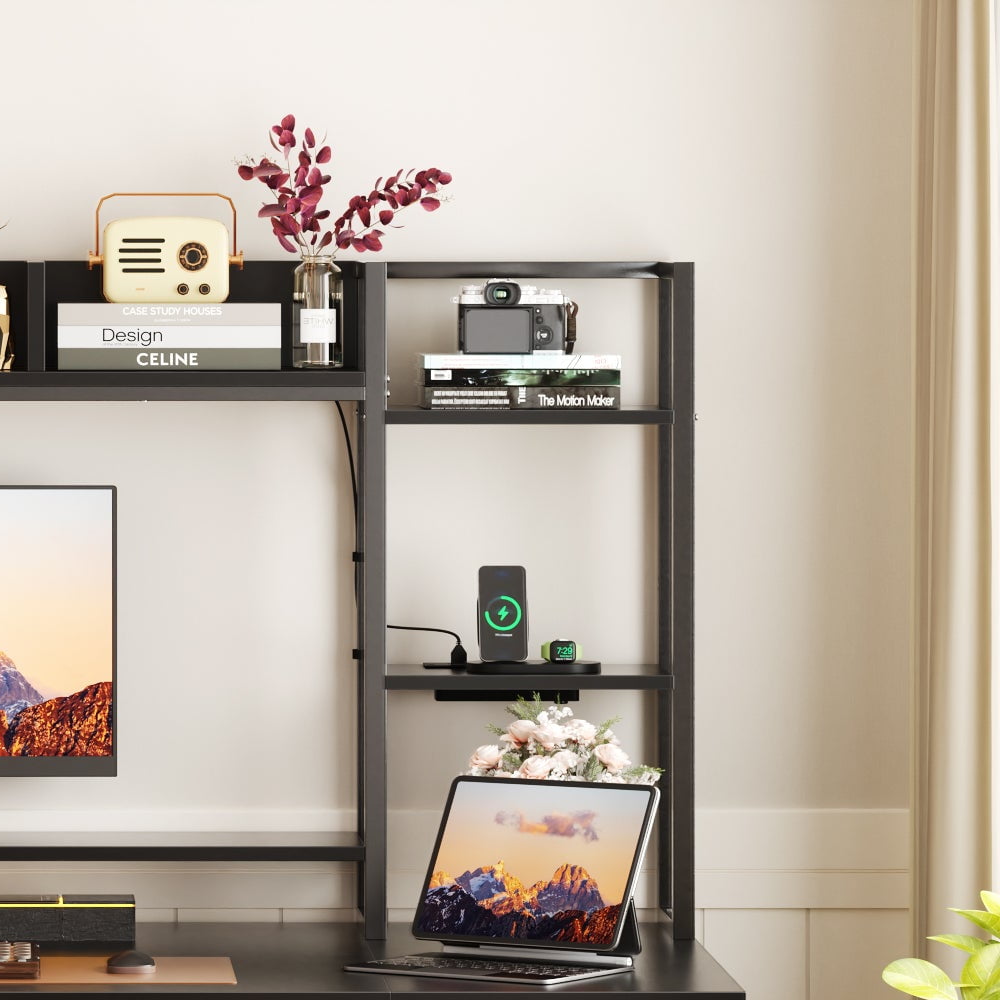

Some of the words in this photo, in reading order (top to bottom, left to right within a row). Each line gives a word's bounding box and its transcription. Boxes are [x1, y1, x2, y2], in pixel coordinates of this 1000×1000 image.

[122, 306, 148, 316] CASE
[150, 306, 181, 316] STUDY
[183, 306, 223, 316] HOUSES
[102, 327, 163, 346] Design
[136, 352, 199, 366] CELINE
[537, 394, 555, 407] The
[556, 394, 585, 407] Motion
[587, 394, 615, 407] Maker
[556, 646, 573, 655] 7:29
